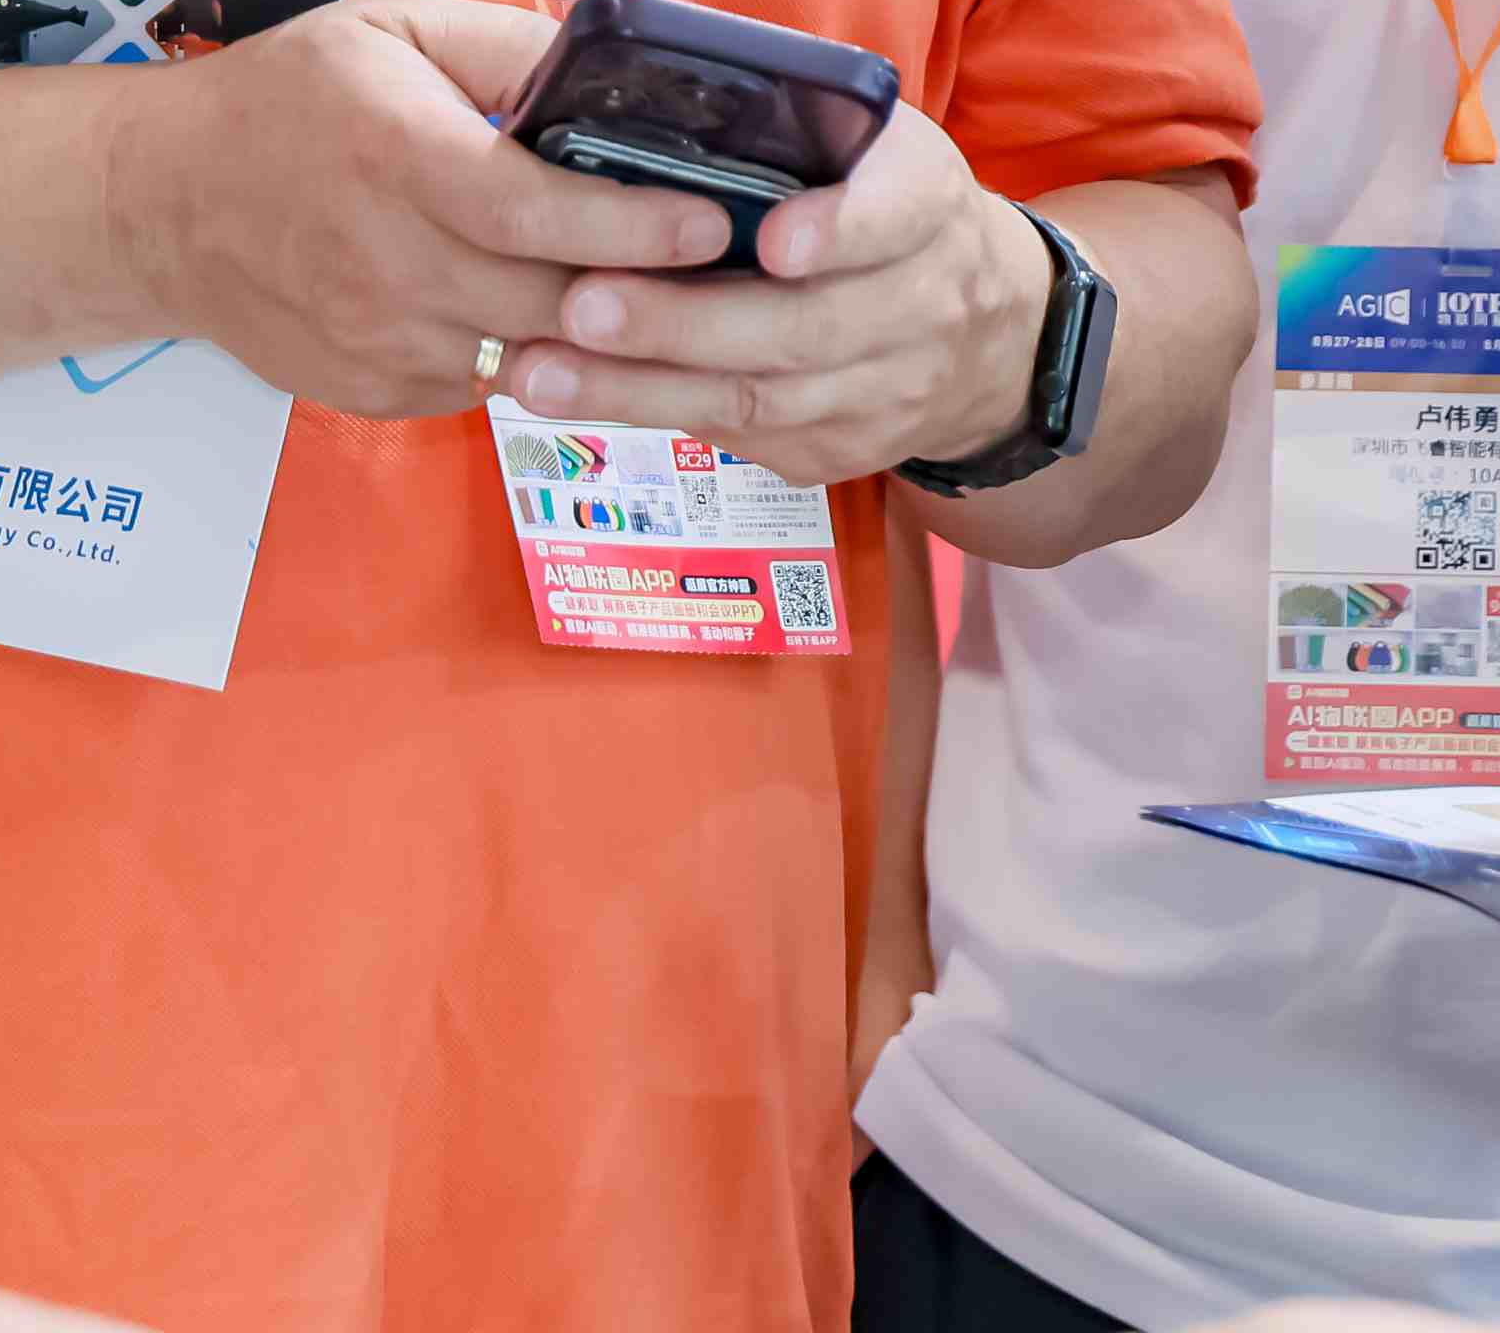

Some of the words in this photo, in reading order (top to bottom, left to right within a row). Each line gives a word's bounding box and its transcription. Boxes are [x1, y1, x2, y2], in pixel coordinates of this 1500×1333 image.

[1338, 289, 1411, 325] AGIC
[1416, 405, 1499, 433] 卢伟勇
[676, 452, 712, 468] 9C29
[27, 529, 122, 566] Co.,Ltd.
